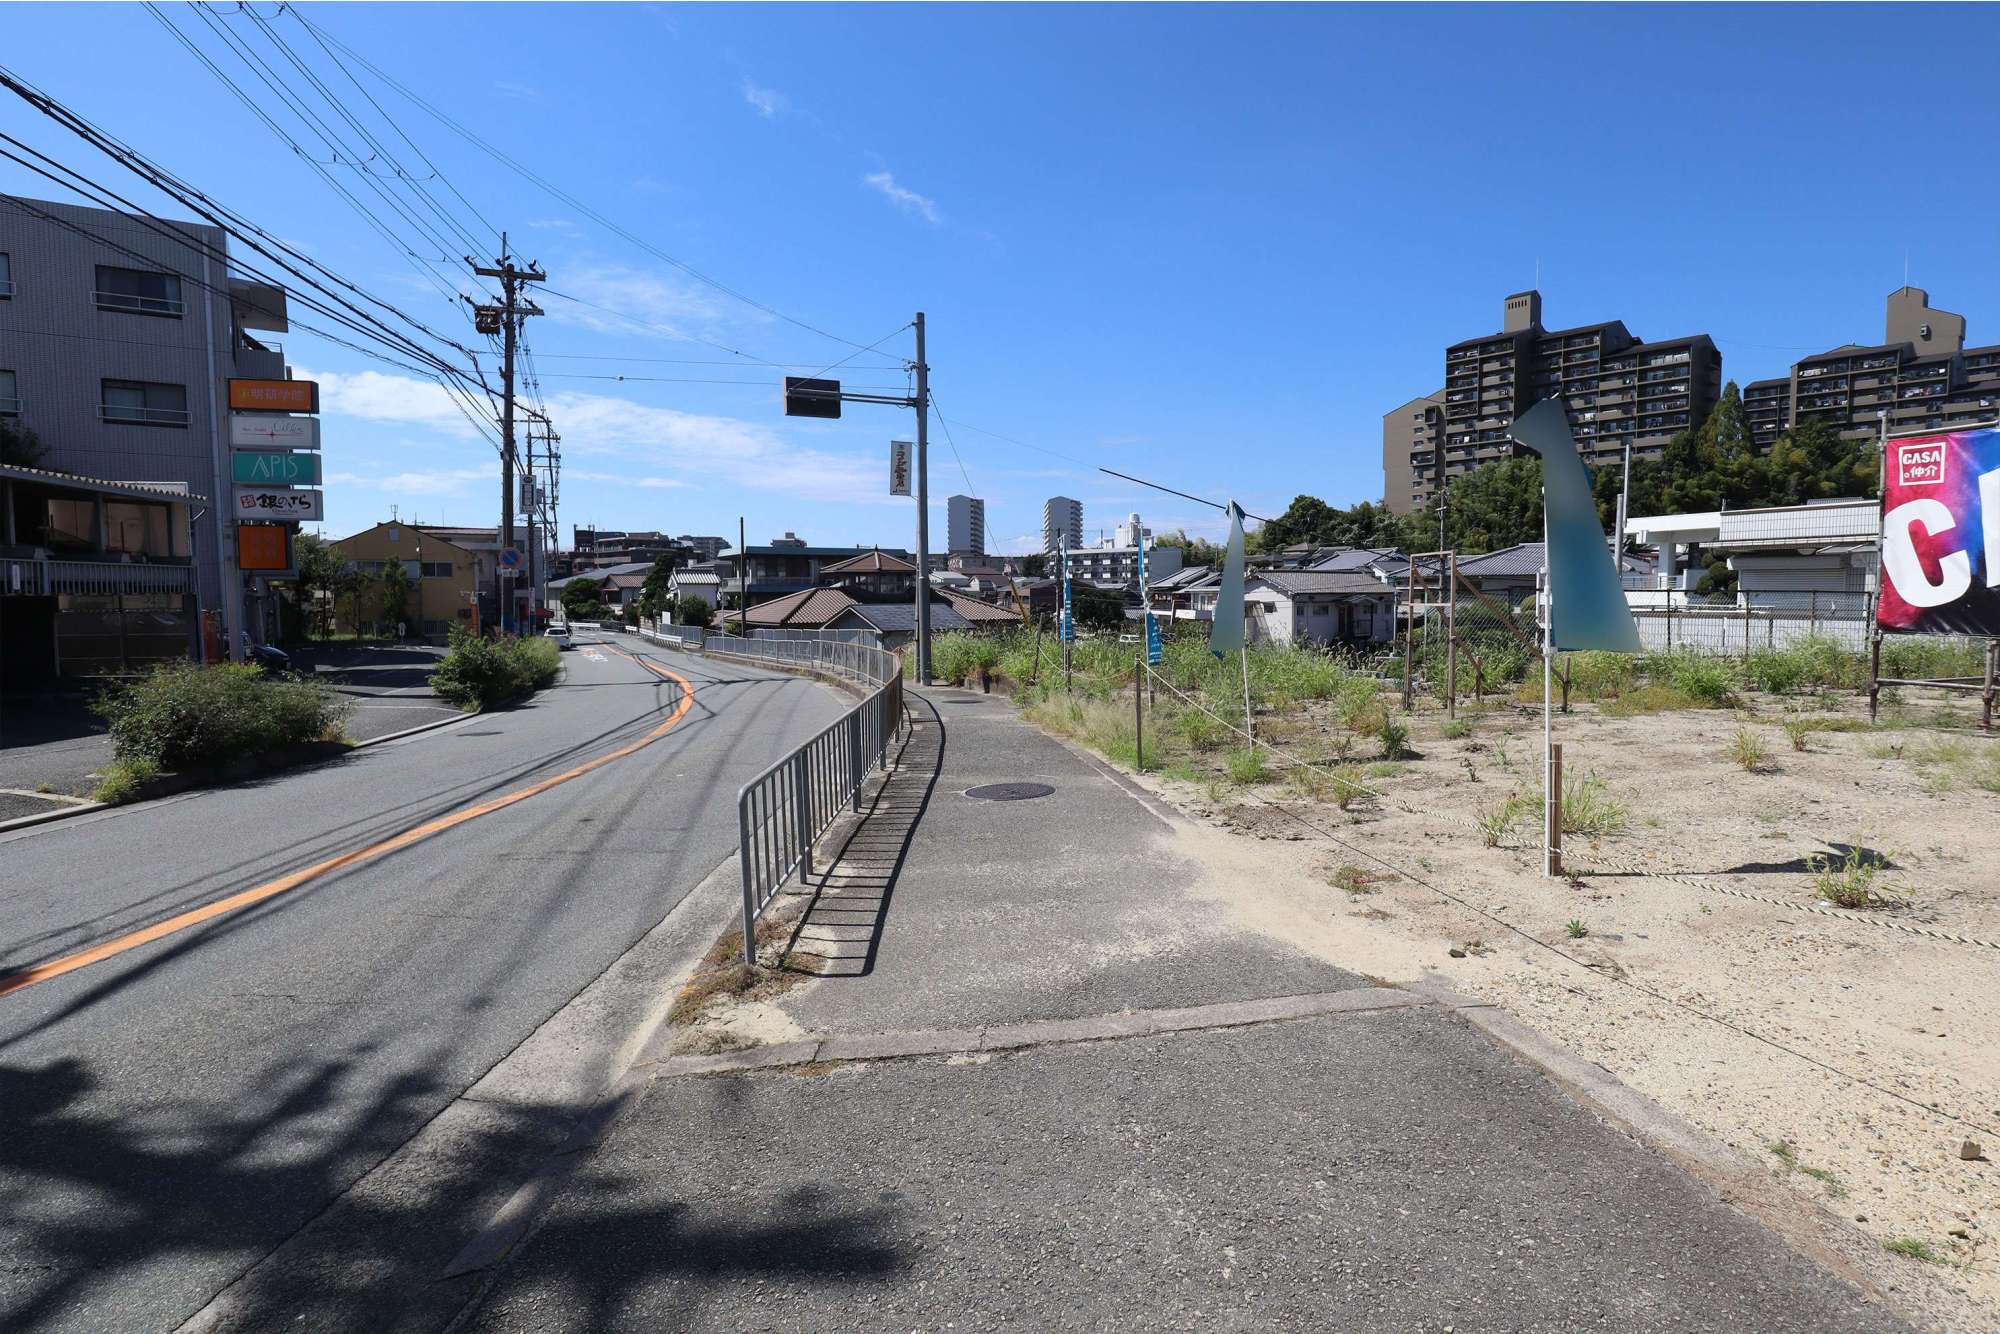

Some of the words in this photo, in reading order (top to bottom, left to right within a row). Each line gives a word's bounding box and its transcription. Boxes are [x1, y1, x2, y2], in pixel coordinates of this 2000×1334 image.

[1902, 450, 1941, 465] CASA
[250, 455, 298, 479] APIS
[1904, 465, 1938, 478] の仲介
[256, 493, 312, 510] 銀のさら
